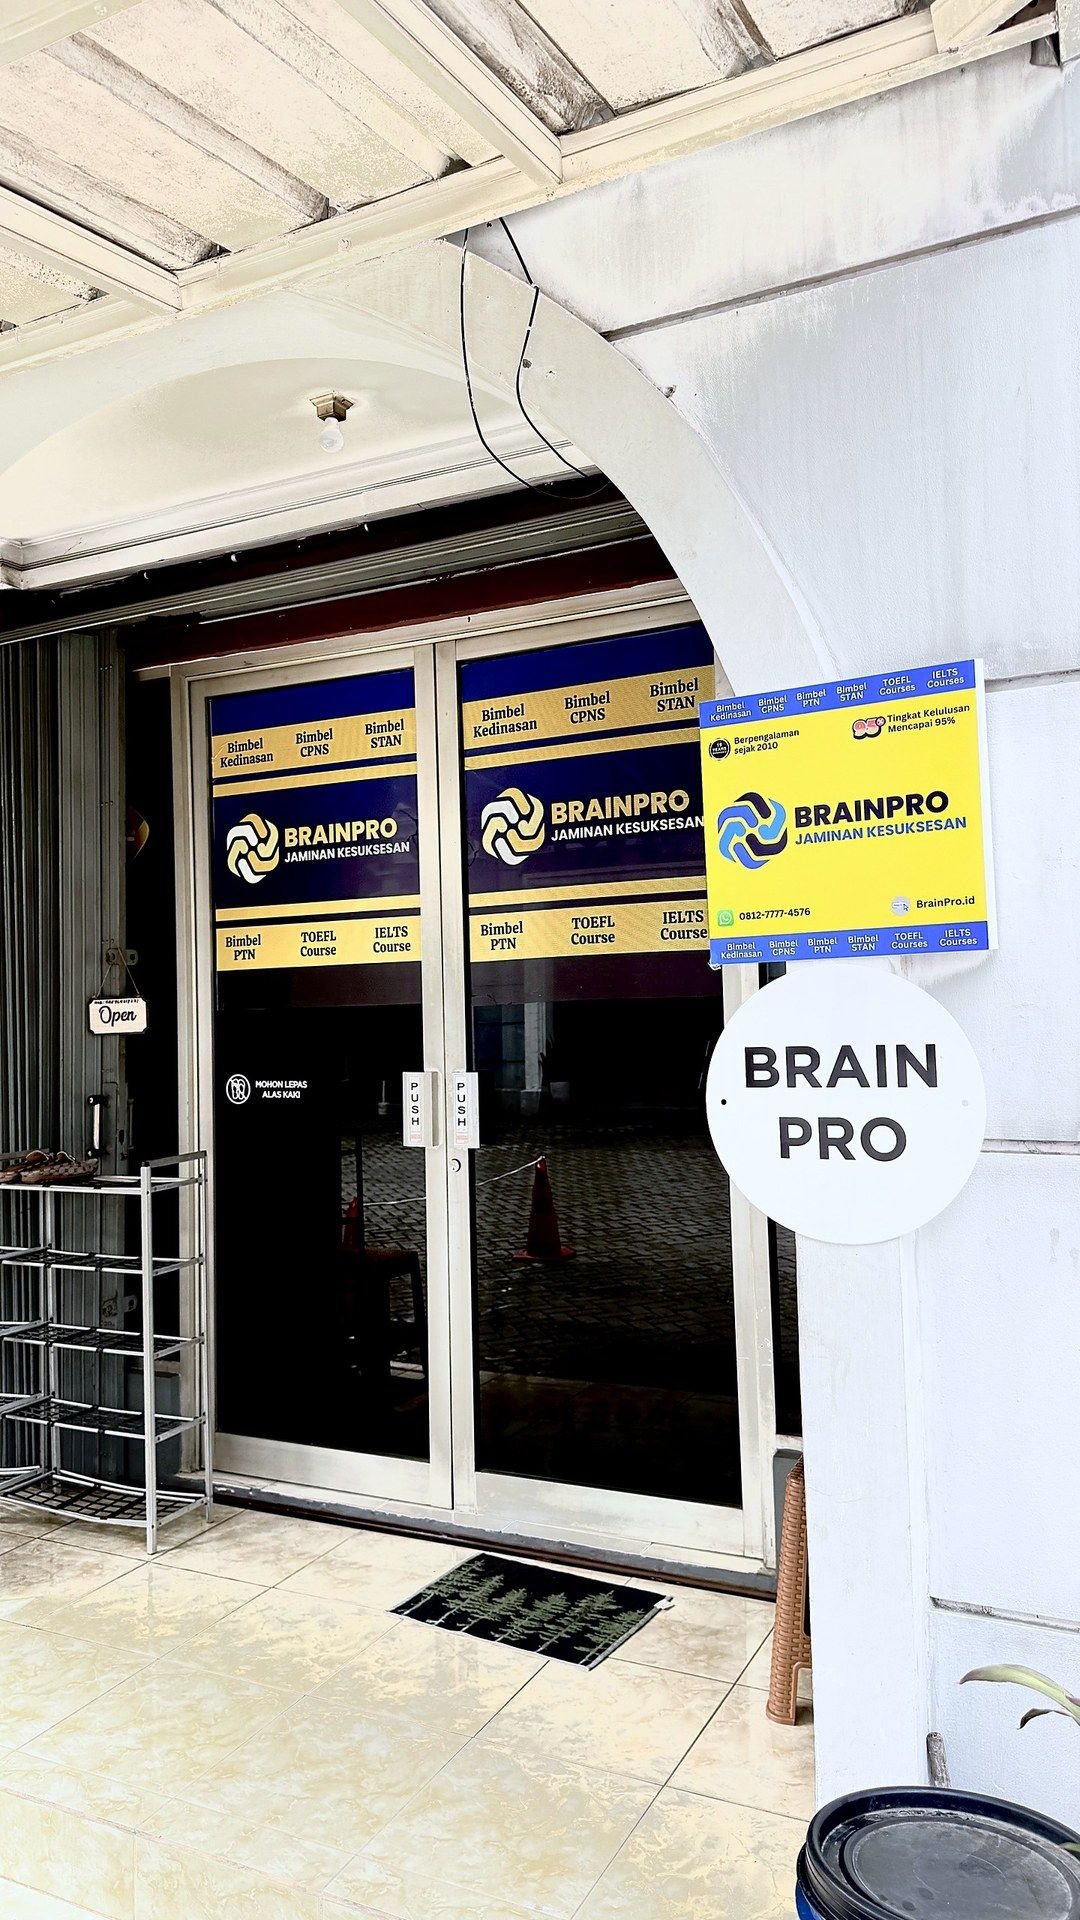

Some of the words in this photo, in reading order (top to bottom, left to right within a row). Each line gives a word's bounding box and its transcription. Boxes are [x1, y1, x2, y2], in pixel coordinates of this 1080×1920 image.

[932, 668, 958, 679] IELTS
[650, 678, 699, 698] Bimbel
[883, 676, 911, 687] TOEFL
[927, 676, 964, 688] Courses
[797, 689, 826, 700] Bimbel
[836, 683, 867, 694] Bimbel
[880, 684, 915, 696] Courses
[565, 691, 610, 710] Bimbel
[758, 696, 787, 706] Bimbel
[803, 699, 820, 707] PTN
[840, 692, 863, 701] STAN
[657, 696, 695, 712] STAN
[717, 701, 744, 712] Bimbel
[762, 704, 784, 713] CPNS
[482, 704, 525, 721] Bimbel
[570, 708, 605, 724] CPNS
[710, 710, 751, 721] Kedinasan
[887, 711, 920, 722] Tingkat
[924, 705, 969, 717] Kelulusan
[365, 719, 404, 735] Bimbel
[473, 719, 537, 738] Kedinasan
[888, 719, 933, 732] Mencapai
[935, 716, 955, 726] 95%
[296, 729, 333, 744] Bimbel
[371, 735, 402, 749] STAN
[734, 730, 799, 744] Berpengalaman
[228, 738, 263, 753] Bimbel
[300, 744, 329, 757] CPNS
[734, 745, 755, 755] sejak
[757, 742, 778, 751] 2010
[220, 752, 273, 768] Kedinasan
[551, 790, 690, 824] BRAINPRO
[795, 791, 948, 828] BRAINPRO
[284, 818, 398, 847] BRAINPRO
[551, 824, 613, 842] JAMINAN
[615, 816, 704, 832] KESUKSESAN
[795, 826, 863, 845] JAMINAN
[866, 816, 966, 838] KESUKSESAN
[284, 848, 336, 863] JAMINAN
[337, 842, 410, 858] KESUKSESAN
[917, 896, 975, 908] BrainPro.id
[663, 910, 704, 924] IELTS
[740, 908, 810, 920] 0812-7777-4576
[481, 921, 523, 936] Bimbel
[572, 916, 615, 929] TOEFL
[301, 931, 336, 943] TOEFL
[375, 926, 408, 939] IELTS
[571, 931, 615, 945] Course
[661, 928, 707, 940] Course
[848, 934, 878, 943] Bimbel
[895, 932, 923, 940] TOEFL
[945, 929, 970, 937] IELTS
[225, 934, 261, 948] Bimbel
[373, 941, 411, 953] Course
[490, 937, 516, 950] PTN
[728, 942, 755, 950] Bimbel
[770, 940, 798, 948] Bimbel
[808, 937, 837, 946] Bimbel
[852, 943, 875, 951] STAN
[892, 940, 928, 949] Courses
[940, 937, 977, 946] Courses
[234, 949, 255, 960] PTN
[300, 944, 336, 956] Course
[721, 950, 762, 958] Kedinasan
[773, 948, 795, 956] CPNS
[99, 1006, 137, 1027] Open
[744, 1044, 937, 1088] BRAIN
[255, 1080, 283, 1088] MOHON
[285, 1080, 307, 1088] LEPAS
[262, 1090, 281, 1098] ALAS
[283, 1090, 300, 1098] KAKI
[411, 1082, 419, 1125] PUSH
[457, 1083, 466, 1126] PUSH
[779, 1117, 906, 1162] PRO
